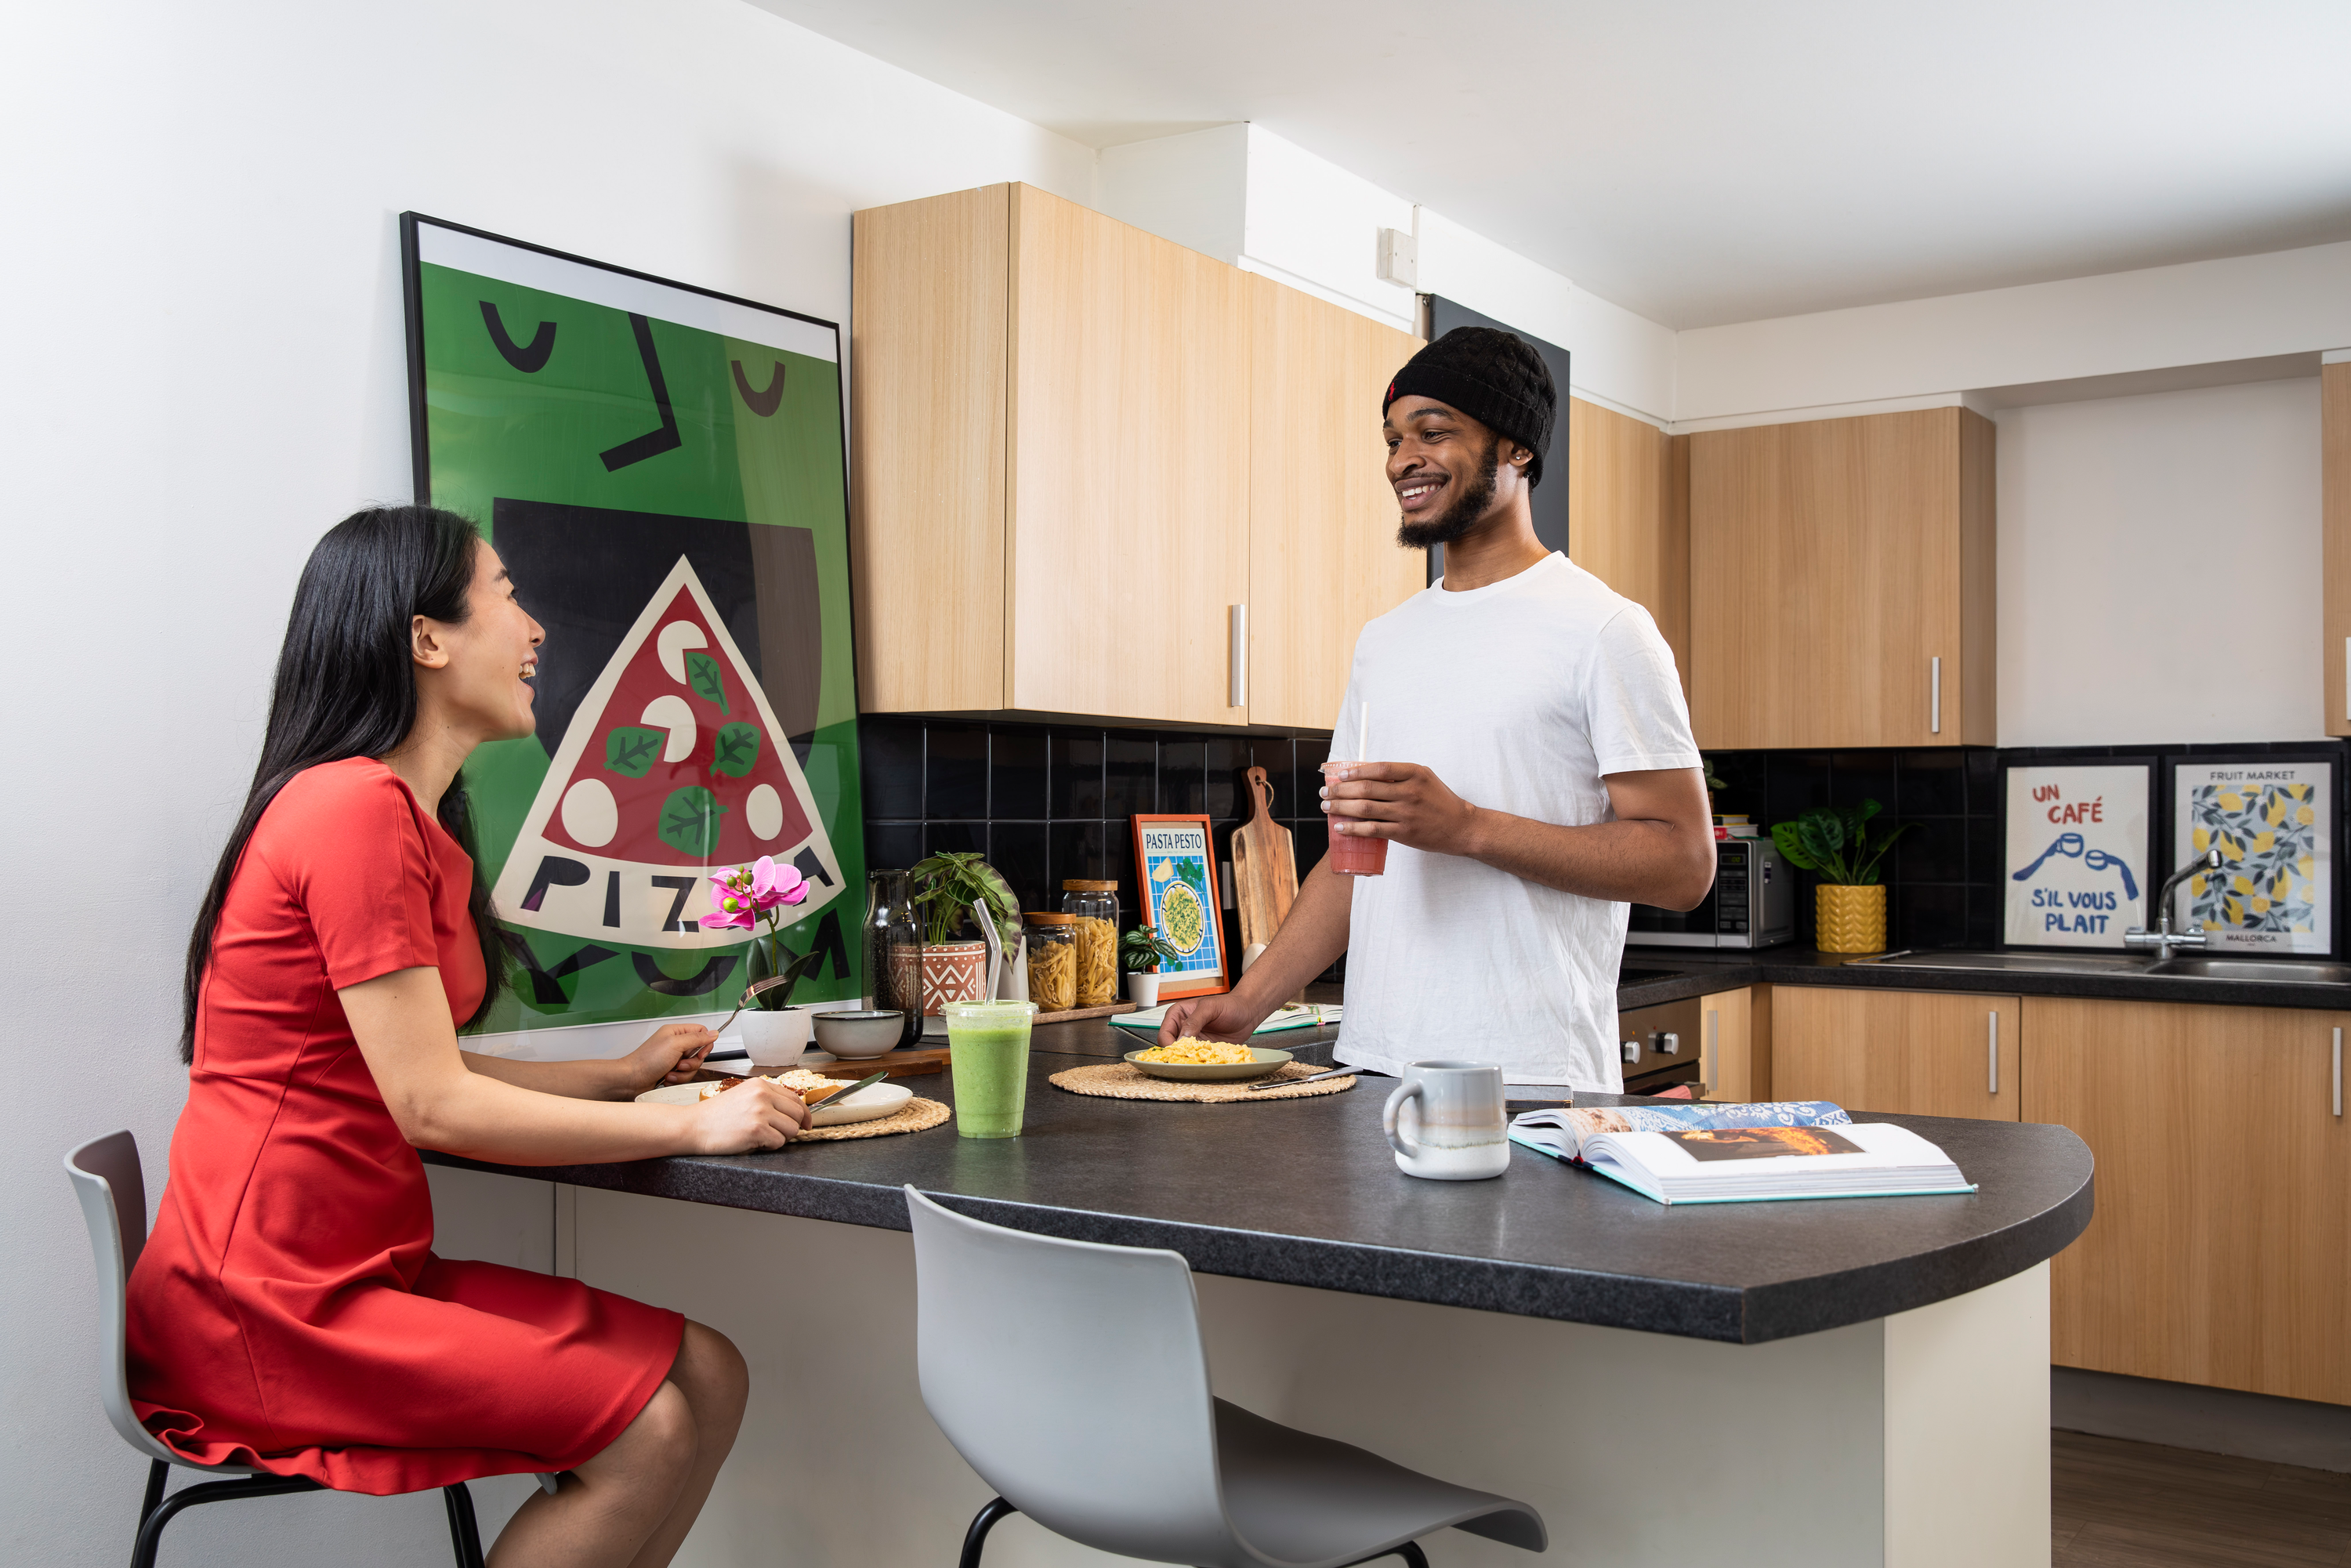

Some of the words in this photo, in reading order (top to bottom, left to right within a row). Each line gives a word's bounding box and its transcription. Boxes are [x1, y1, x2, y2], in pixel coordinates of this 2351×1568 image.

[2210, 771, 2243, 780] FRUIT
[2246, 770, 2295, 780] MARKET
[2033, 784, 2059, 802] UN
[2048, 795, 2103, 824] CAFÉ
[1146, 834, 1174, 849] PASTA
[1175, 834, 1202, 849] PESTO
[520, 846, 835, 933] PIZA
[2031, 888, 2064, 907] S'IL
[2067, 891, 2117, 910] VOUS
[2045, 913, 2110, 934] PLAIT
